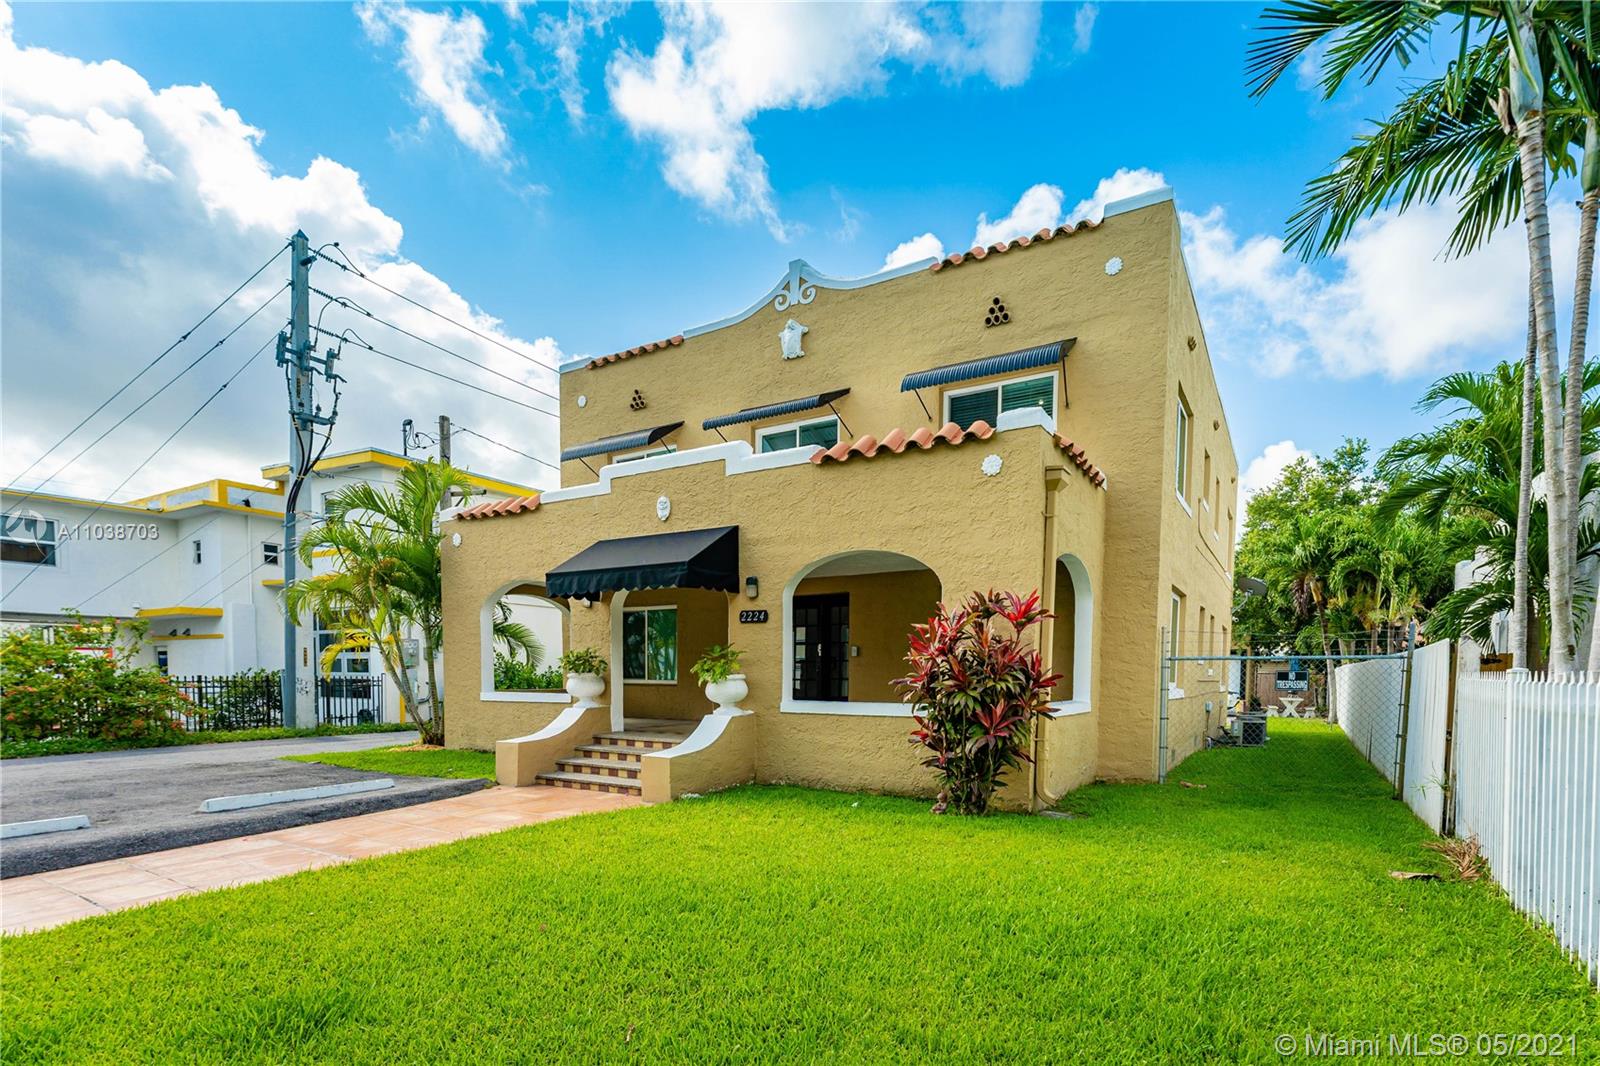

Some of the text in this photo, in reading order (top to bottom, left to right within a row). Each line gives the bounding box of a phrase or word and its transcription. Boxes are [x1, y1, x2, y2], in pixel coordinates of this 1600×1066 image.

[741, 611, 765, 621] 2224
[1288, 671, 1296, 681] NO
[1276, 680, 1308, 690] TRESPASSING
